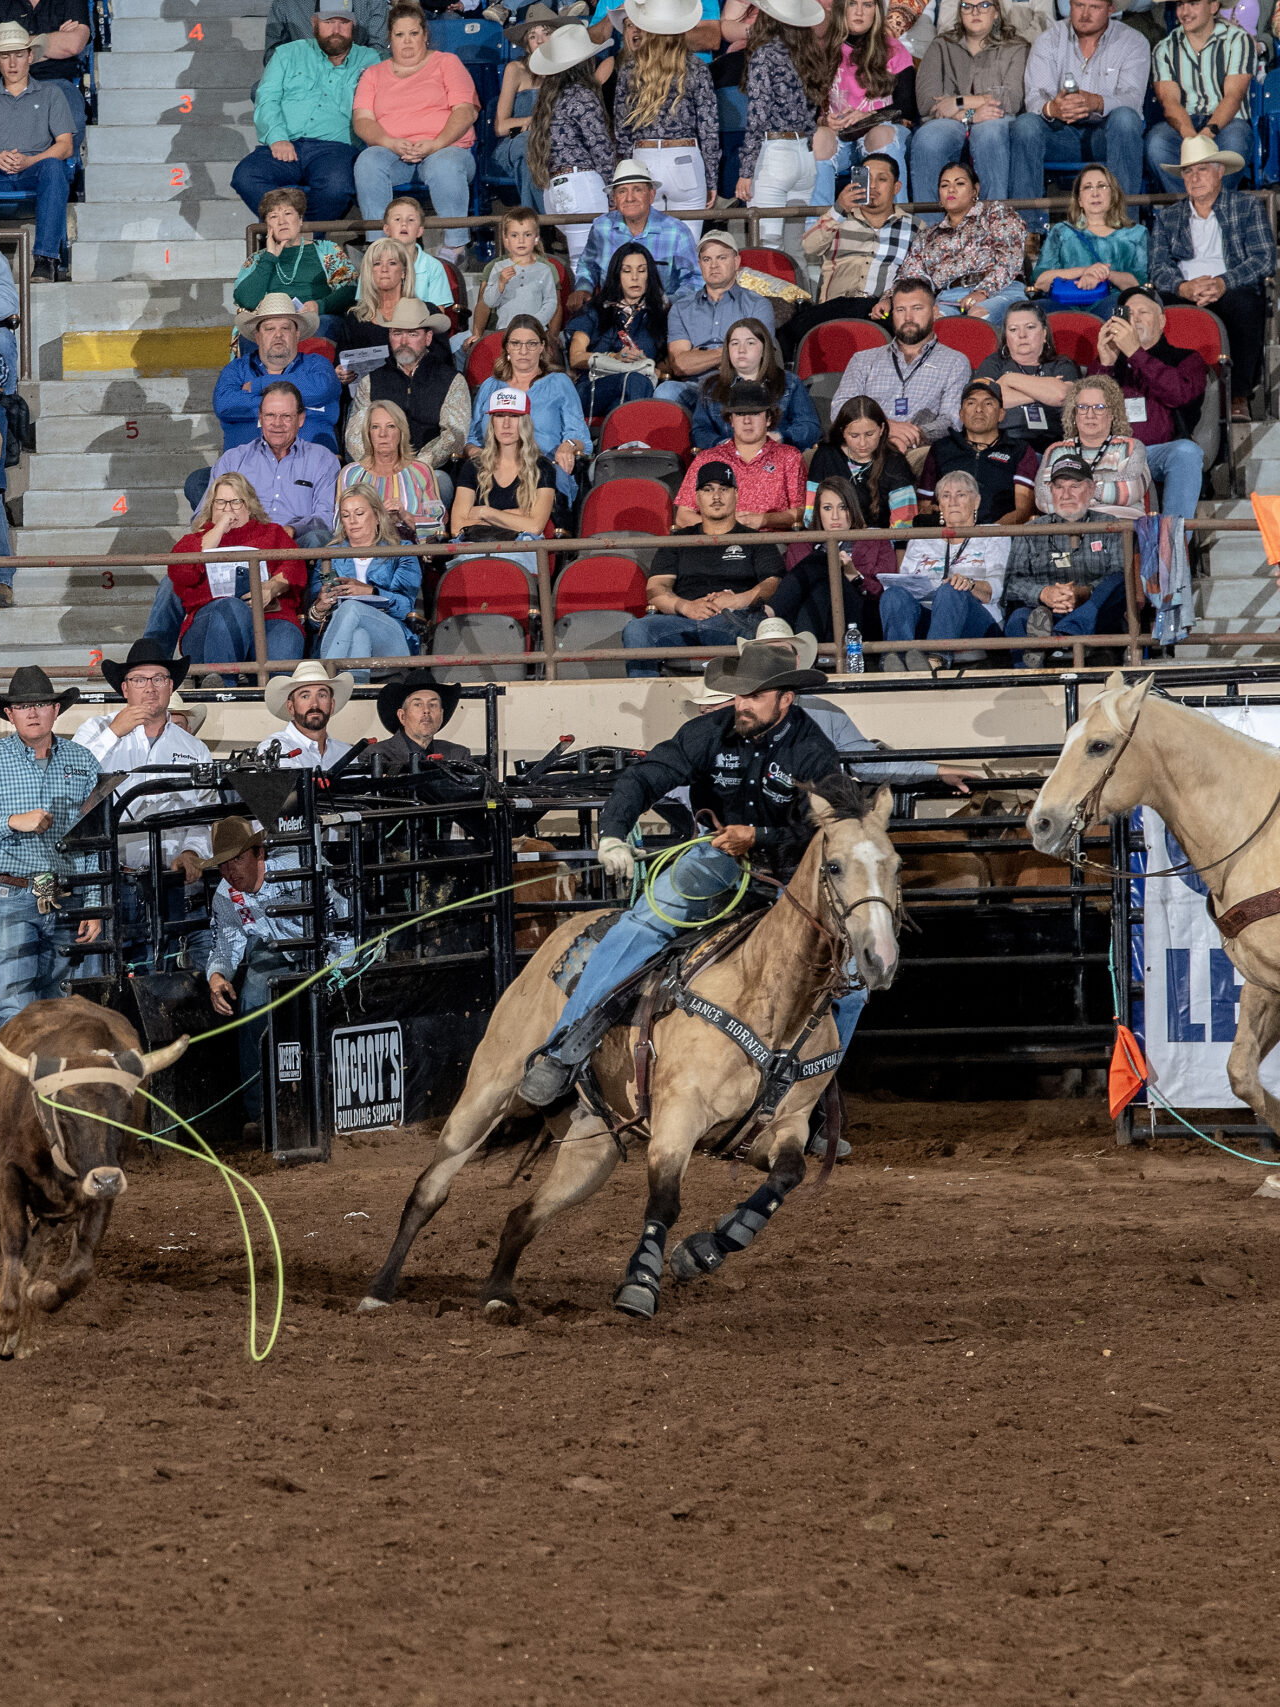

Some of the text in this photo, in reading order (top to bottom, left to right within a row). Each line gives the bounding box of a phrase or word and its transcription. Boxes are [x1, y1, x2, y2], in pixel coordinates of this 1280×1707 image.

[188, 23, 204, 41] 4
[179, 95, 193, 113] 3
[170, 168, 183, 186] 2
[165, 249, 169, 264] 1
[496, 392, 517, 400] Coors
[126, 421, 139, 439] 5
[112, 495, 128, 515] 4
[101, 571, 115, 589] 3
[278, 815, 303, 832] Priefert
[689, 997, 723, 1024] LANCE
[725, 1019, 769, 1063] HORNER
[337, 1107, 372, 1129] BUILDING
